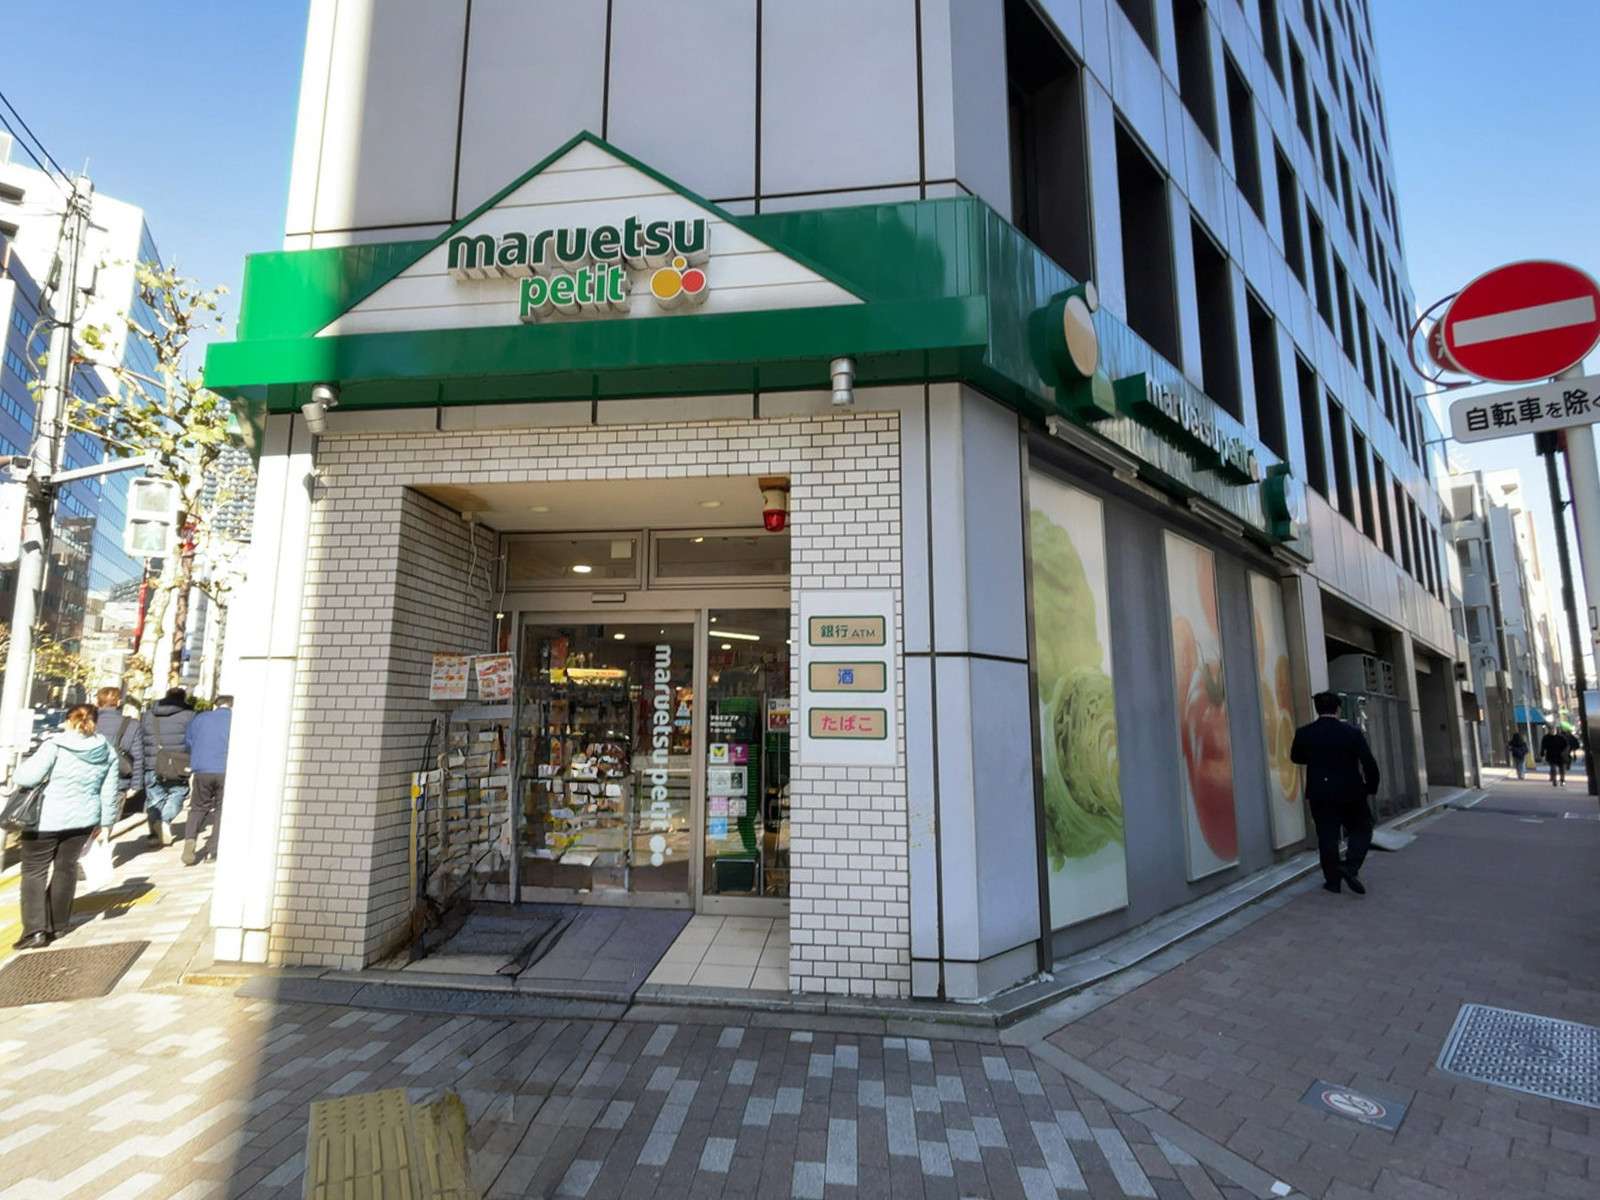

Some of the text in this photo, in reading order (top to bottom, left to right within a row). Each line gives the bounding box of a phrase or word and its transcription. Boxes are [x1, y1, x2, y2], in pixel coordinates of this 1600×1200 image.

[447, 215, 705, 270] maruetsu
[519, 264, 627, 317] petit
[820, 624, 876, 638] 銀行 ATM
[837, 668, 854, 685] 酒
[648, 645, 672, 830] maruetsu petit
[820, 715, 873, 732] たばこ
